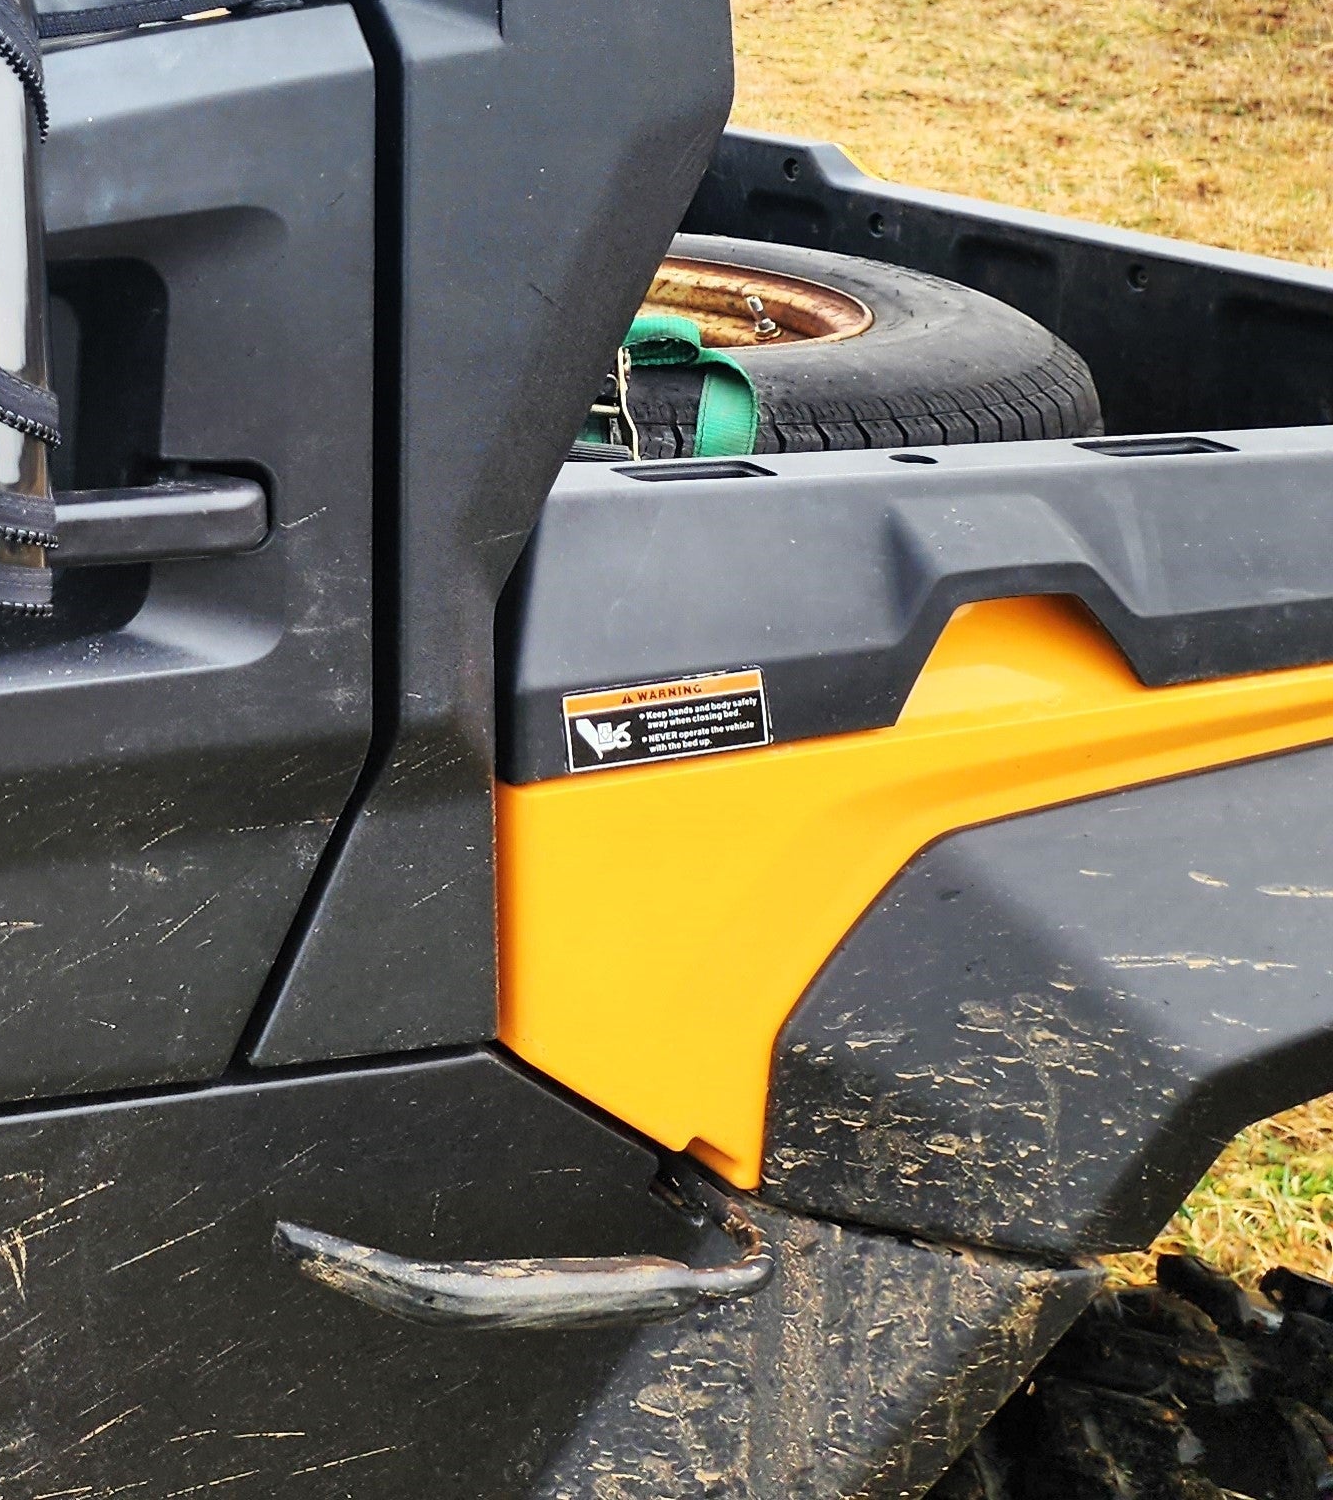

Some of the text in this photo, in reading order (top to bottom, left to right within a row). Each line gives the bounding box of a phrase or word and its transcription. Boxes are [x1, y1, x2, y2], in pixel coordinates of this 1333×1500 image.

[637, 684, 702, 701] WARNING
[646, 697, 757, 720] Keep hands and body safely
[647, 709, 741, 729] away when closing bed.
[648, 720, 754, 743] NEVER operate the vehicle
[649, 737, 712, 753] with the bed up.
